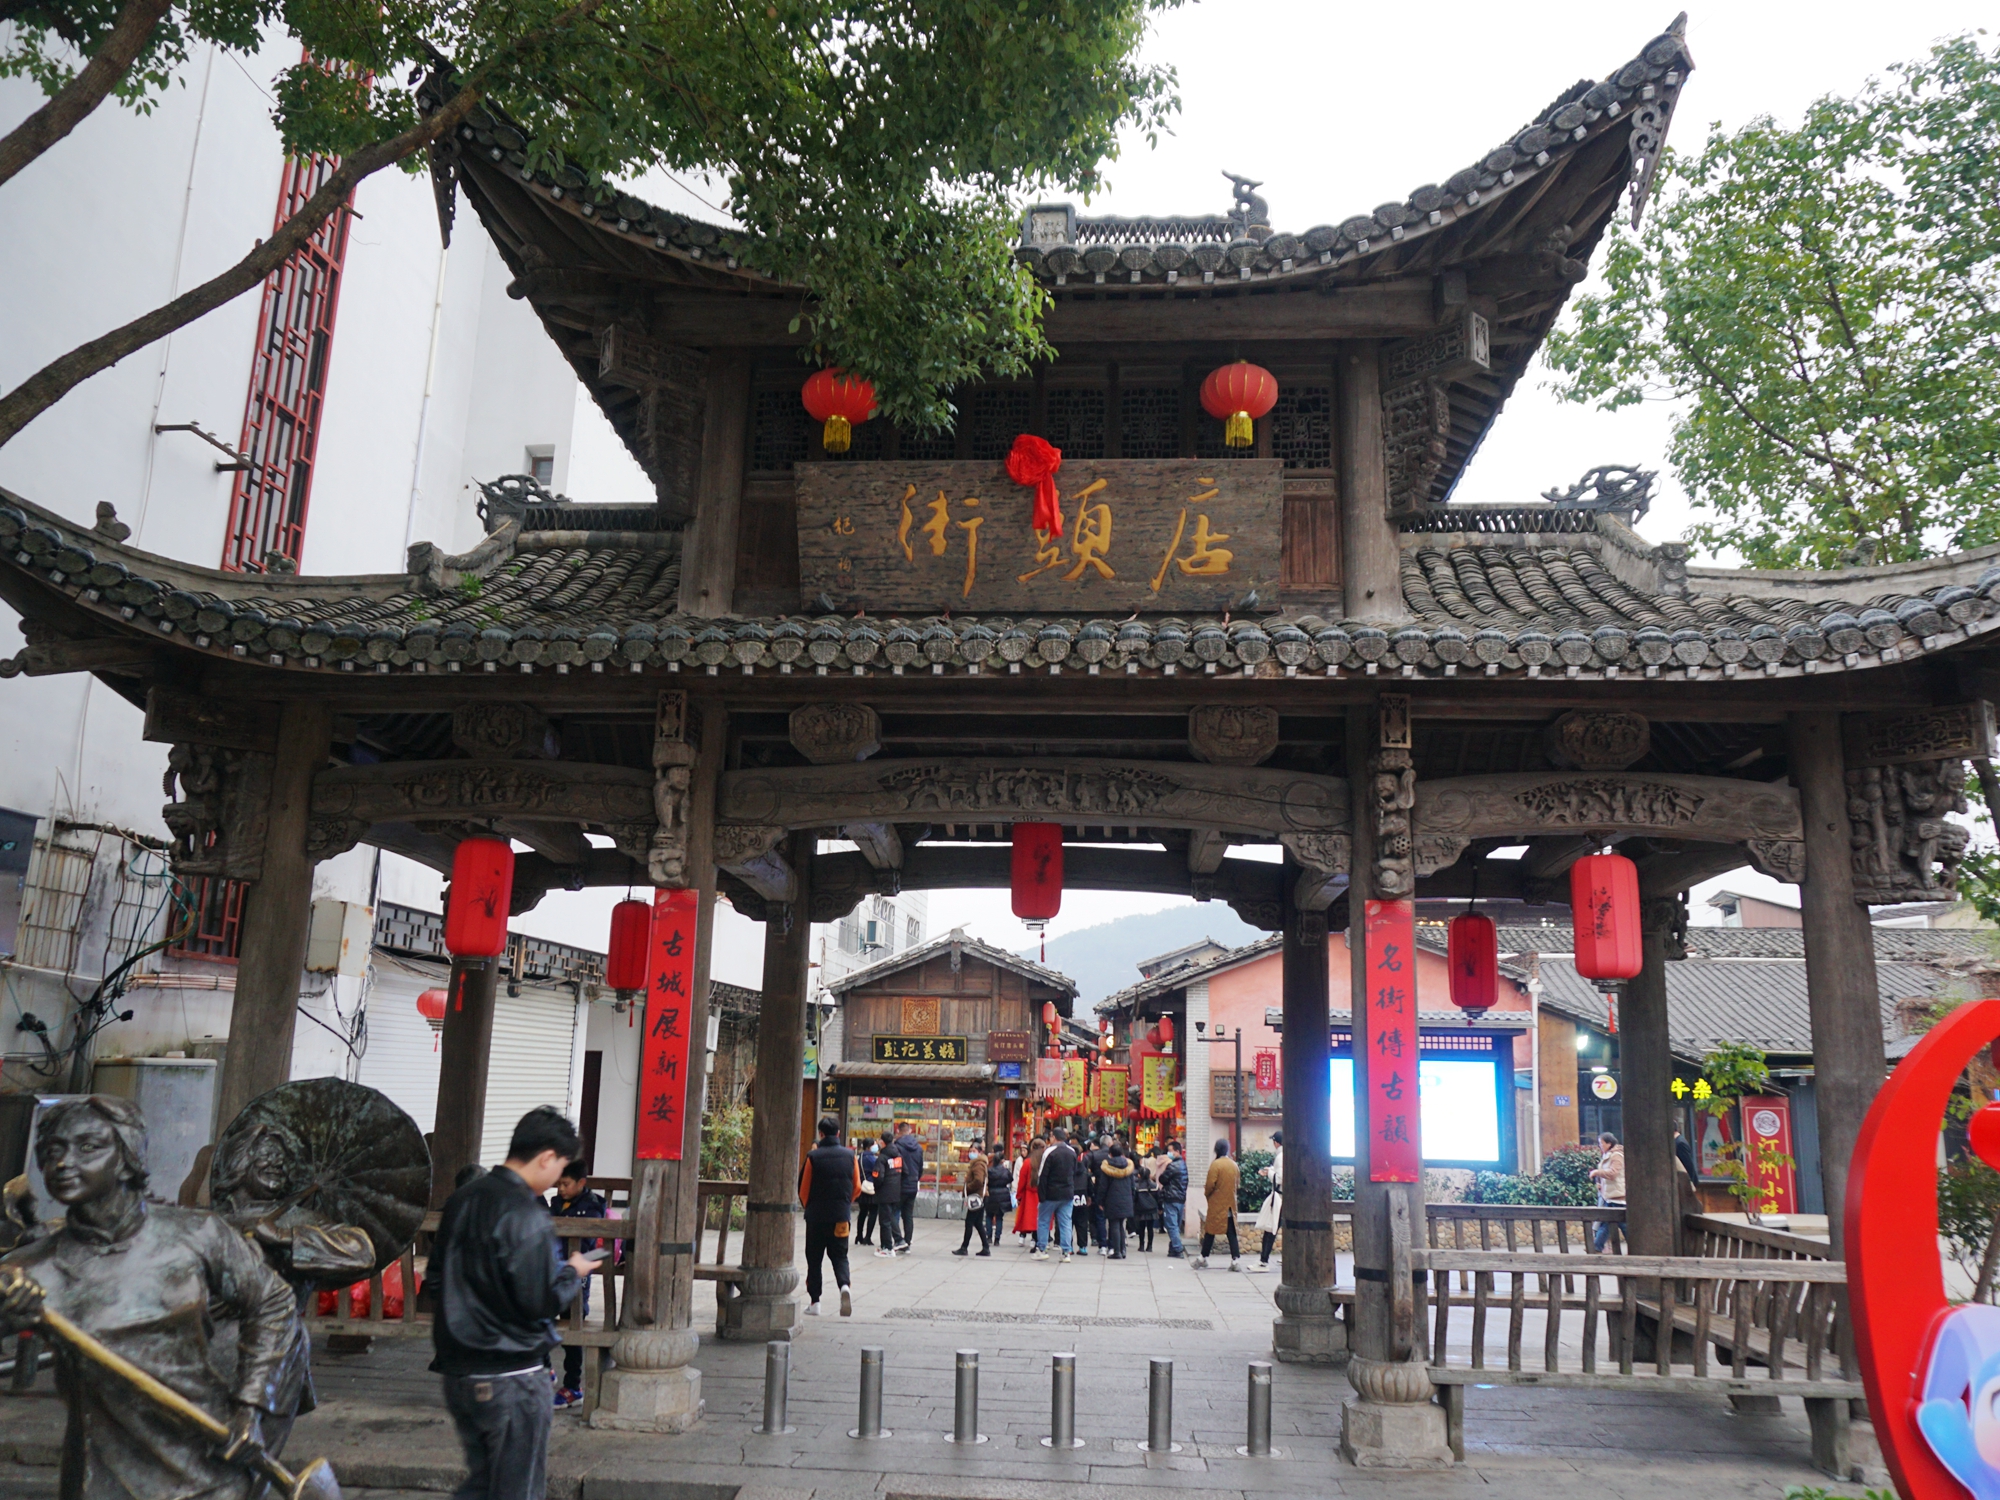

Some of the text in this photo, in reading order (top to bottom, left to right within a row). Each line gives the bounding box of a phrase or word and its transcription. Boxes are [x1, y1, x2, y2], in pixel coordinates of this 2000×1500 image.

[647, 929, 685, 1123] 古城展新姿
[1670, 1077, 1713, 1100] 牛杂
